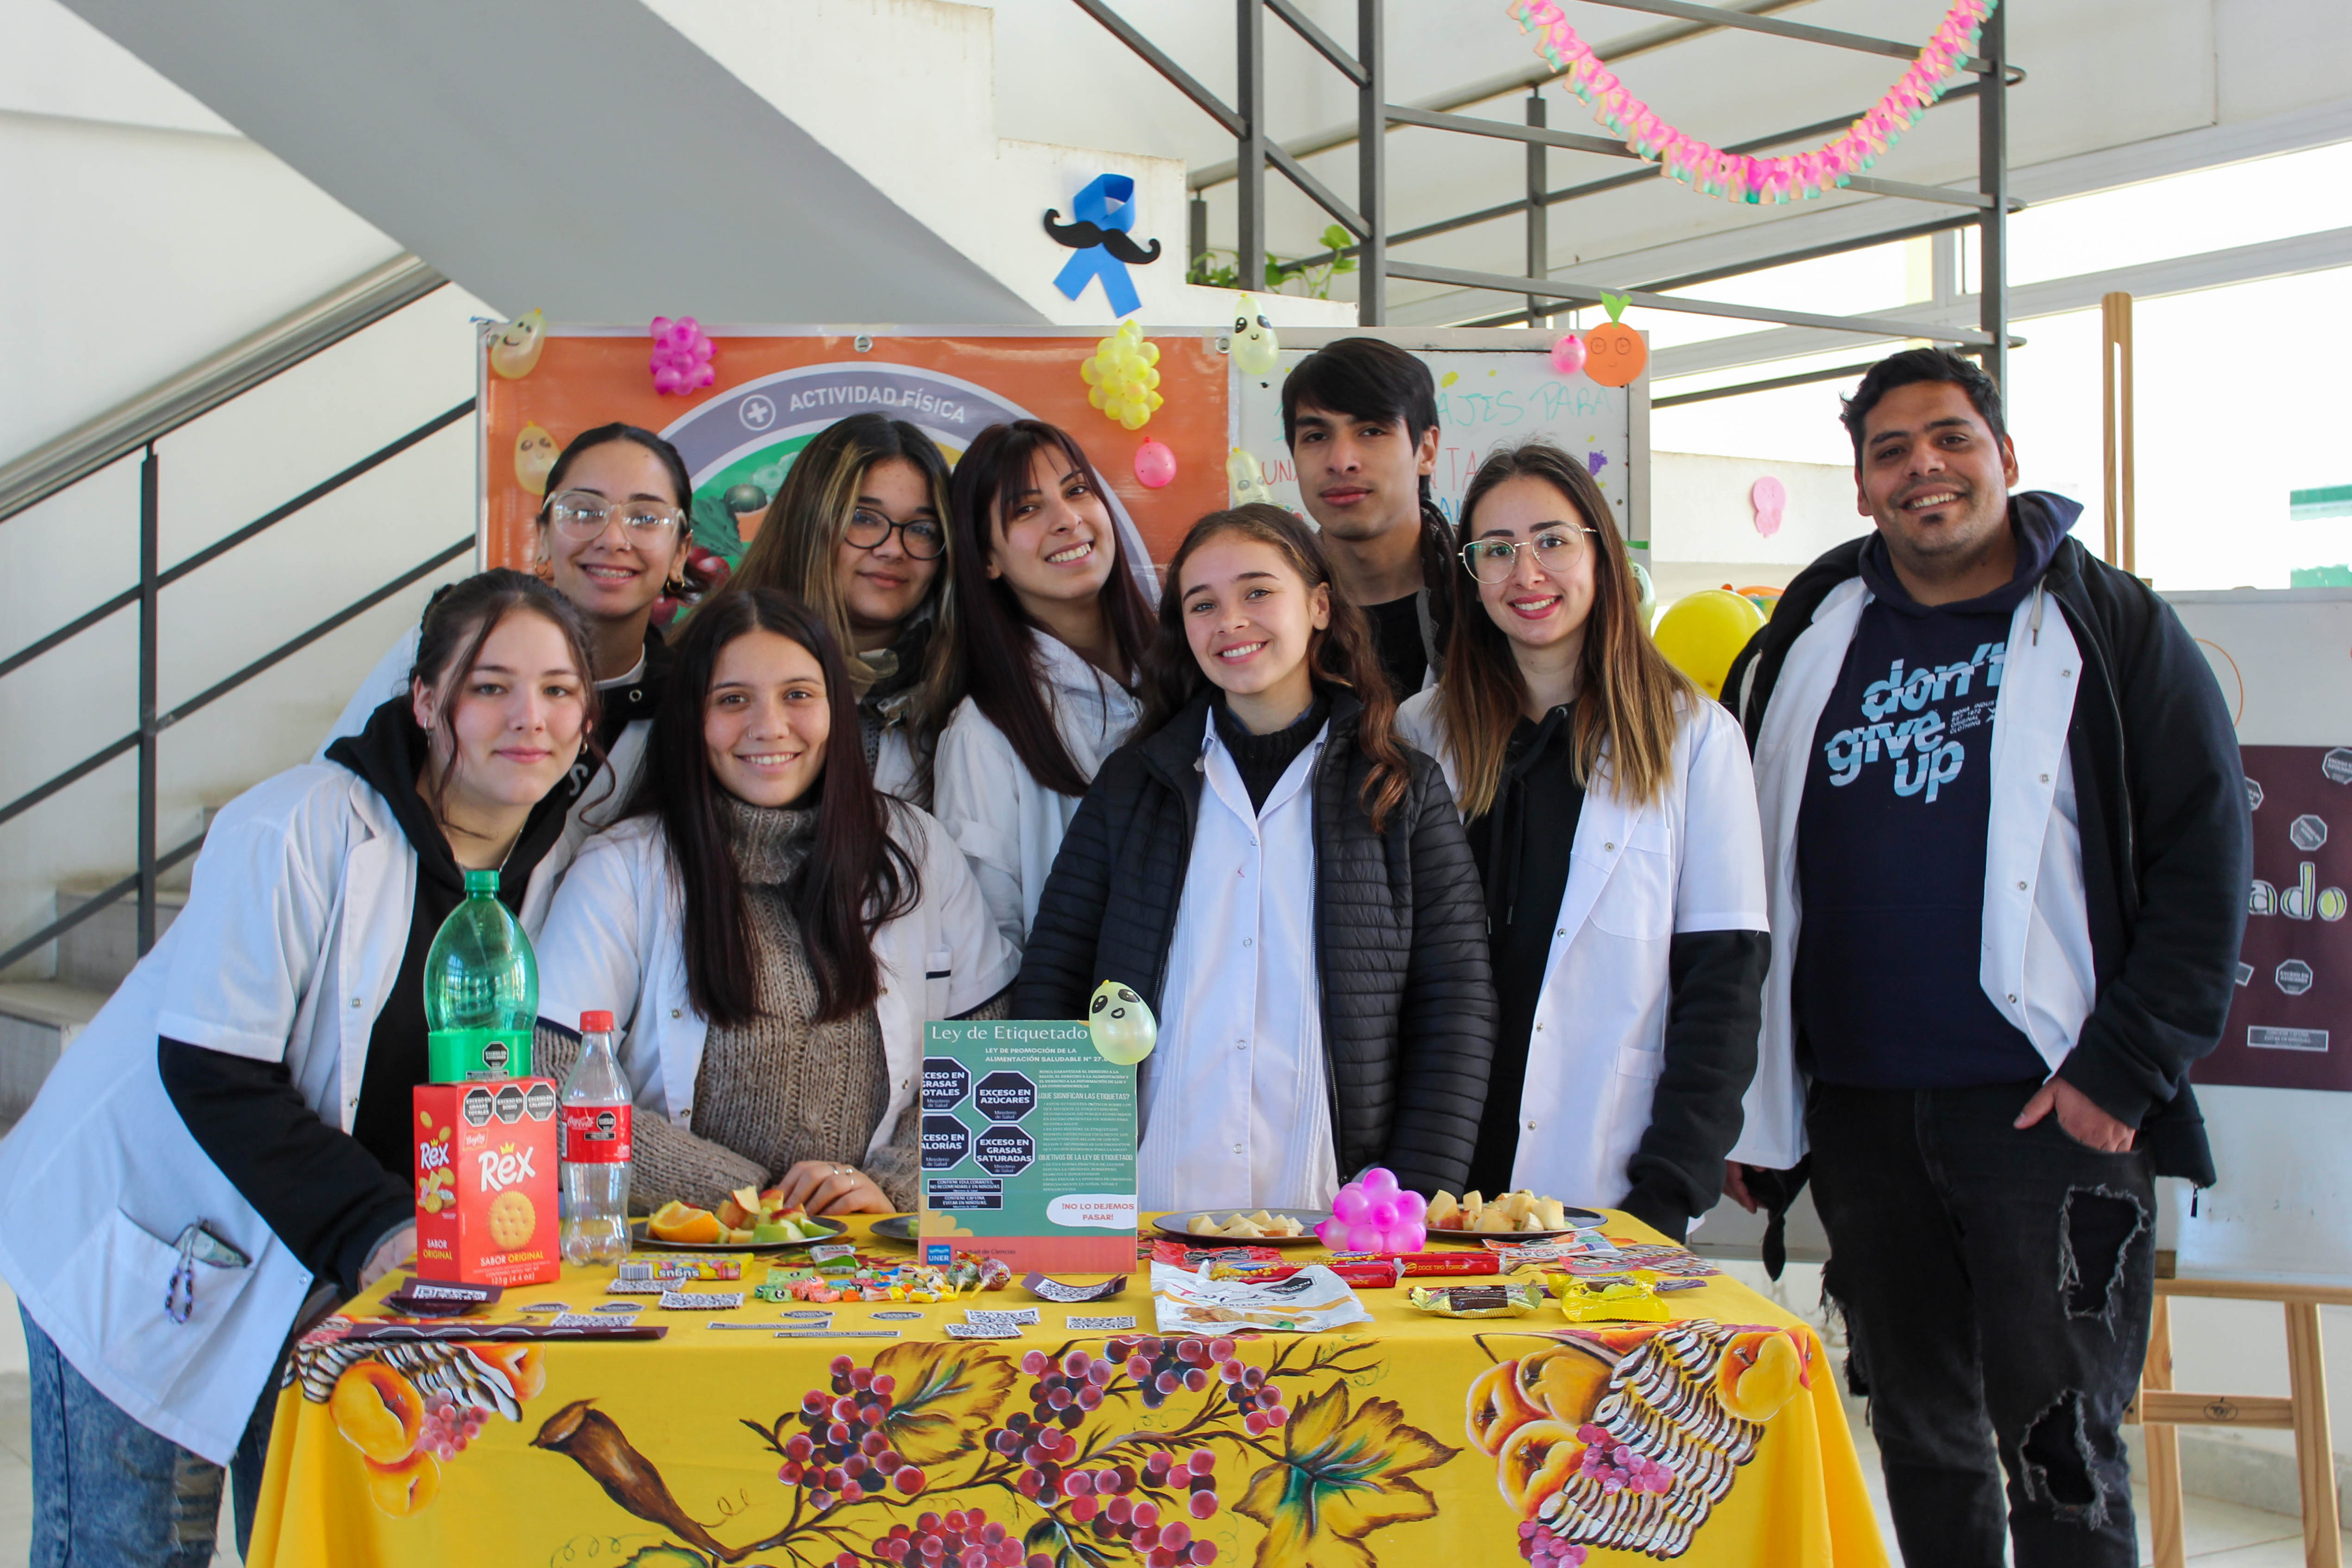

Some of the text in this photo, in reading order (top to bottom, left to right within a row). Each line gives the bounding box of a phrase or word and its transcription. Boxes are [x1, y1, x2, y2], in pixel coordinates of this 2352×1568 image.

[790, 386, 964, 424] ACTIVIDAD FÍSICA
[1261, 460, 1298, 485] UN
[1861, 642, 2005, 722] don't
[1974, 700, 1996, 708] INDUS
[1950, 719, 1980, 734] CLOTHING
[1824, 710, 1945, 787] give
[1894, 741, 1965, 804] up
[2248, 861, 2347, 921] ado
[931, 1025, 1088, 1043] Ley de Etiquetado
[921, 1141, 962, 1150] ALORÍAS
[427, 1239, 448, 1249] SABOR
[423, 1249, 453, 1260] ORIGINAL
[480, 1250, 544, 1266] SABOR ORIGINAL
